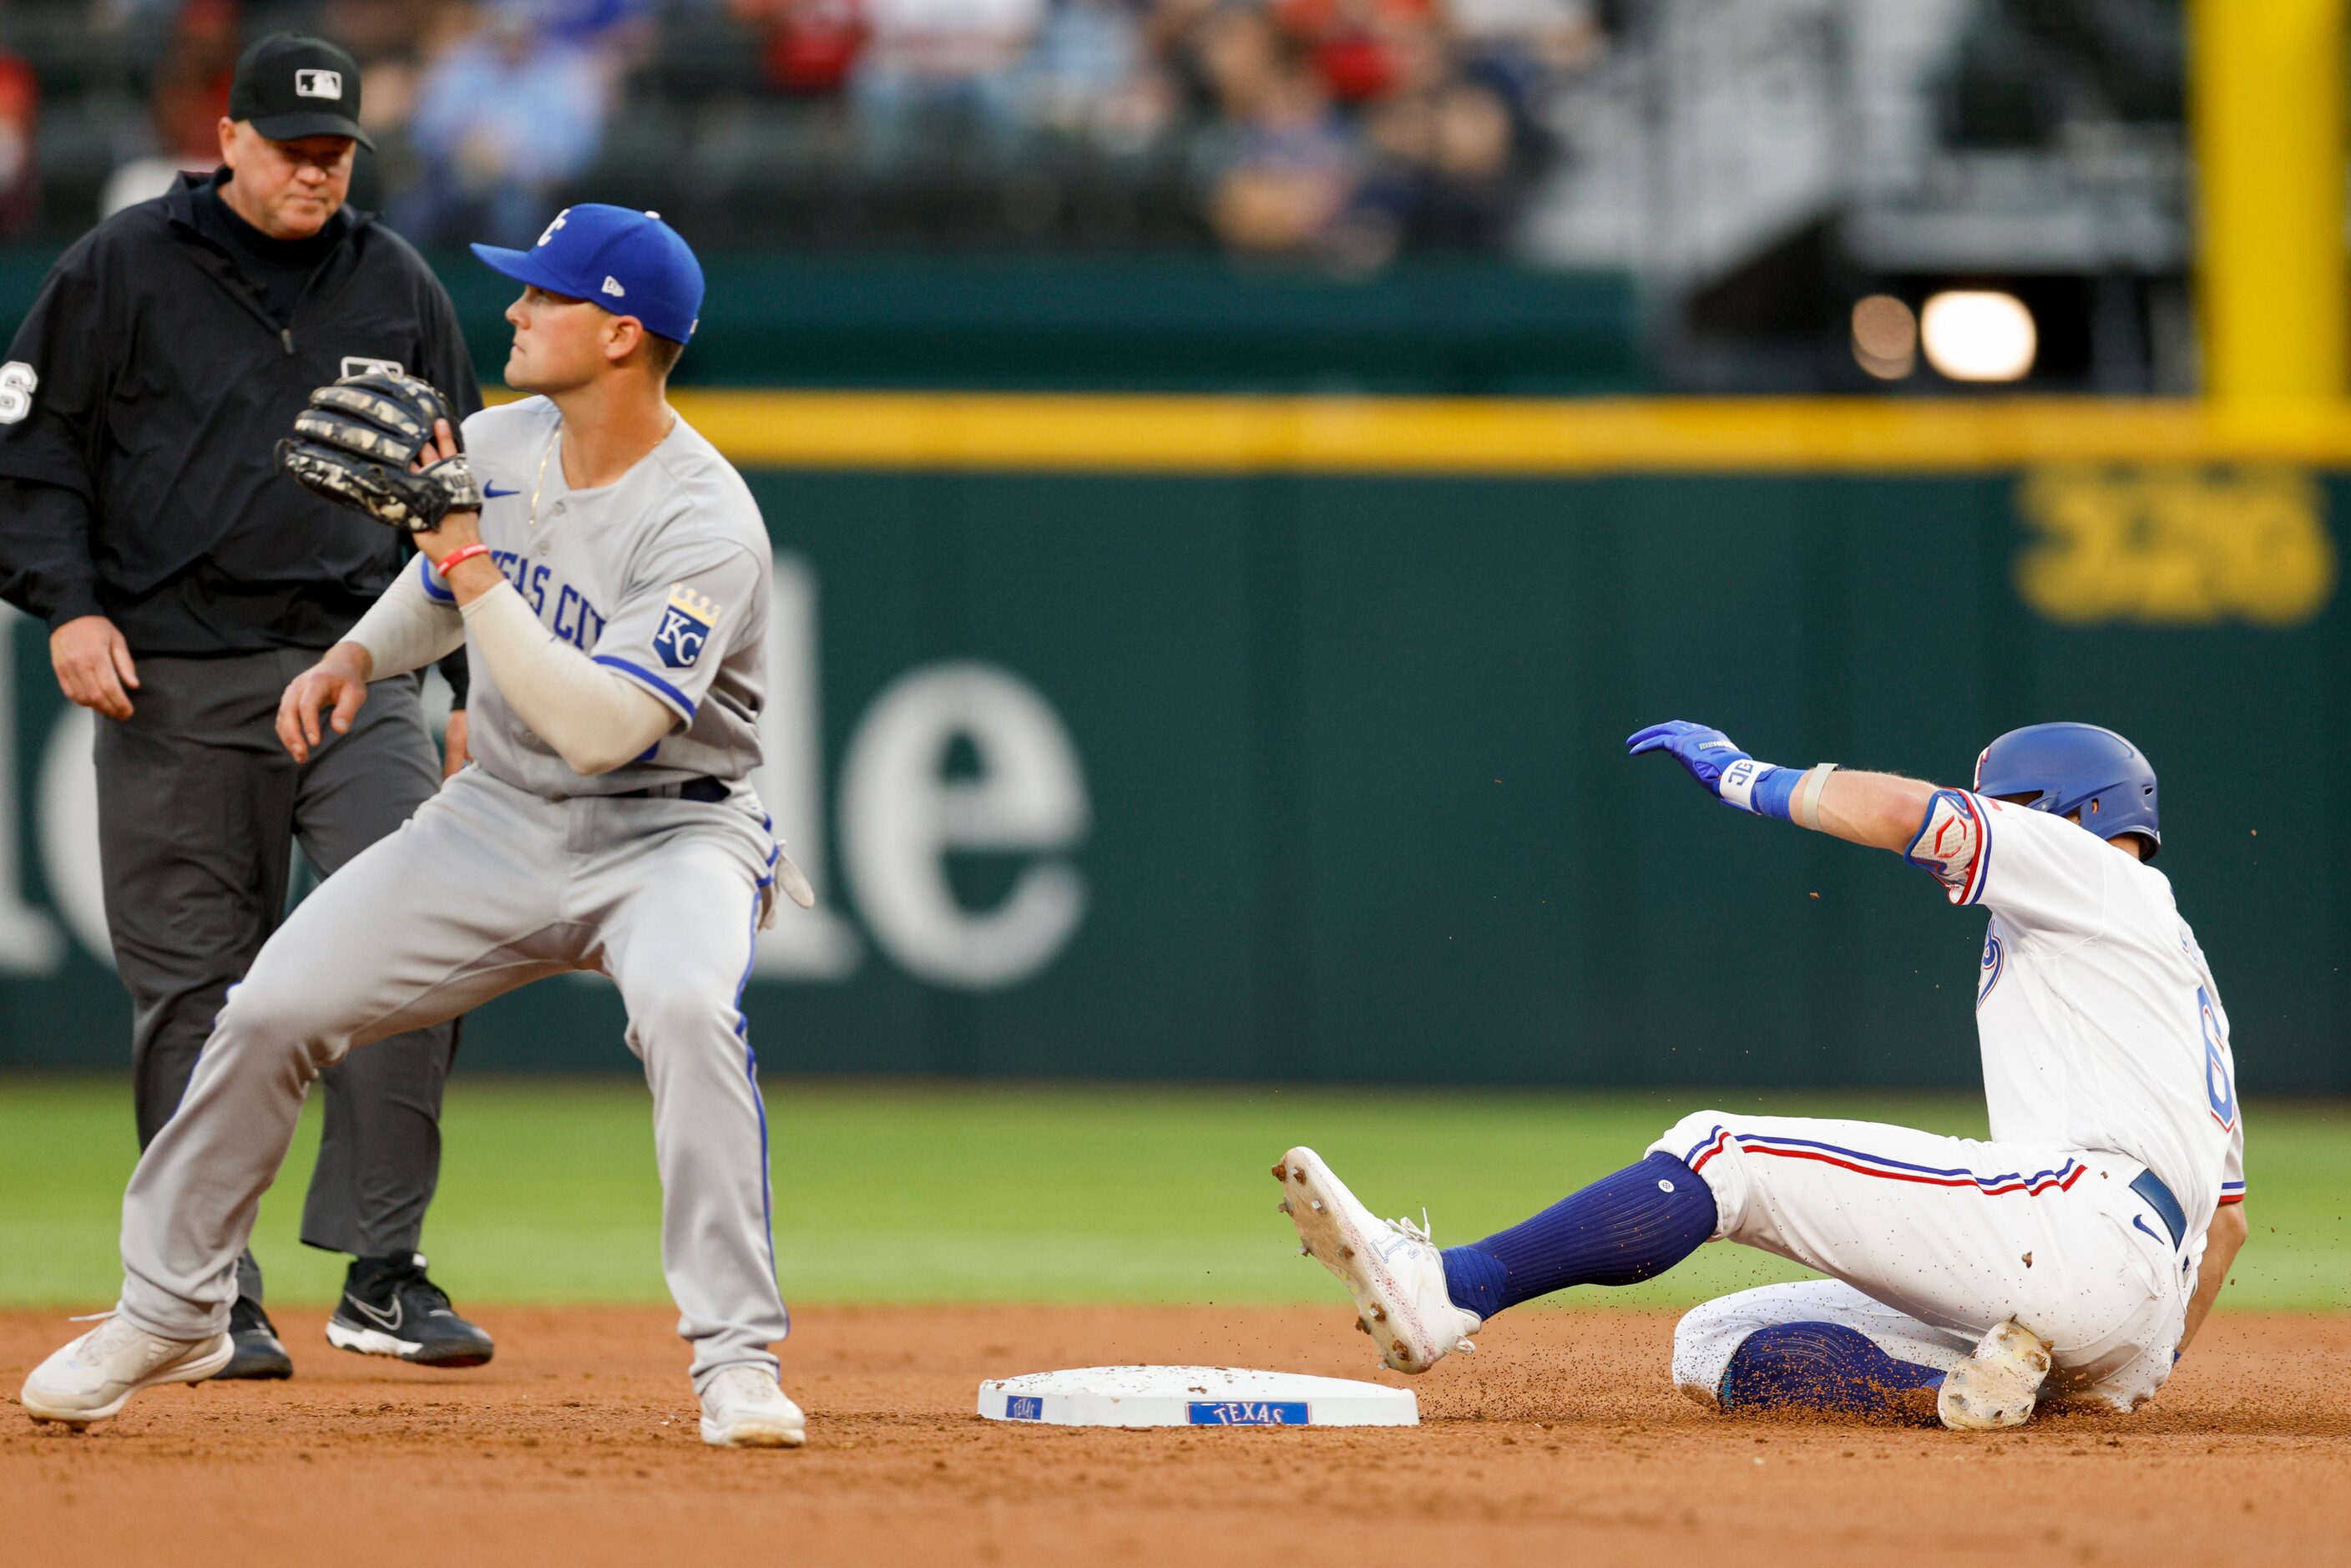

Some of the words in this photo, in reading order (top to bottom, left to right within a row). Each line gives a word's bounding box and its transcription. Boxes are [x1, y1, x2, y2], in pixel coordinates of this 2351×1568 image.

[656, 609, 704, 665] KC
[2197, 984, 2236, 1133] 6
[1213, 1403, 1283, 1424] TEXAS
